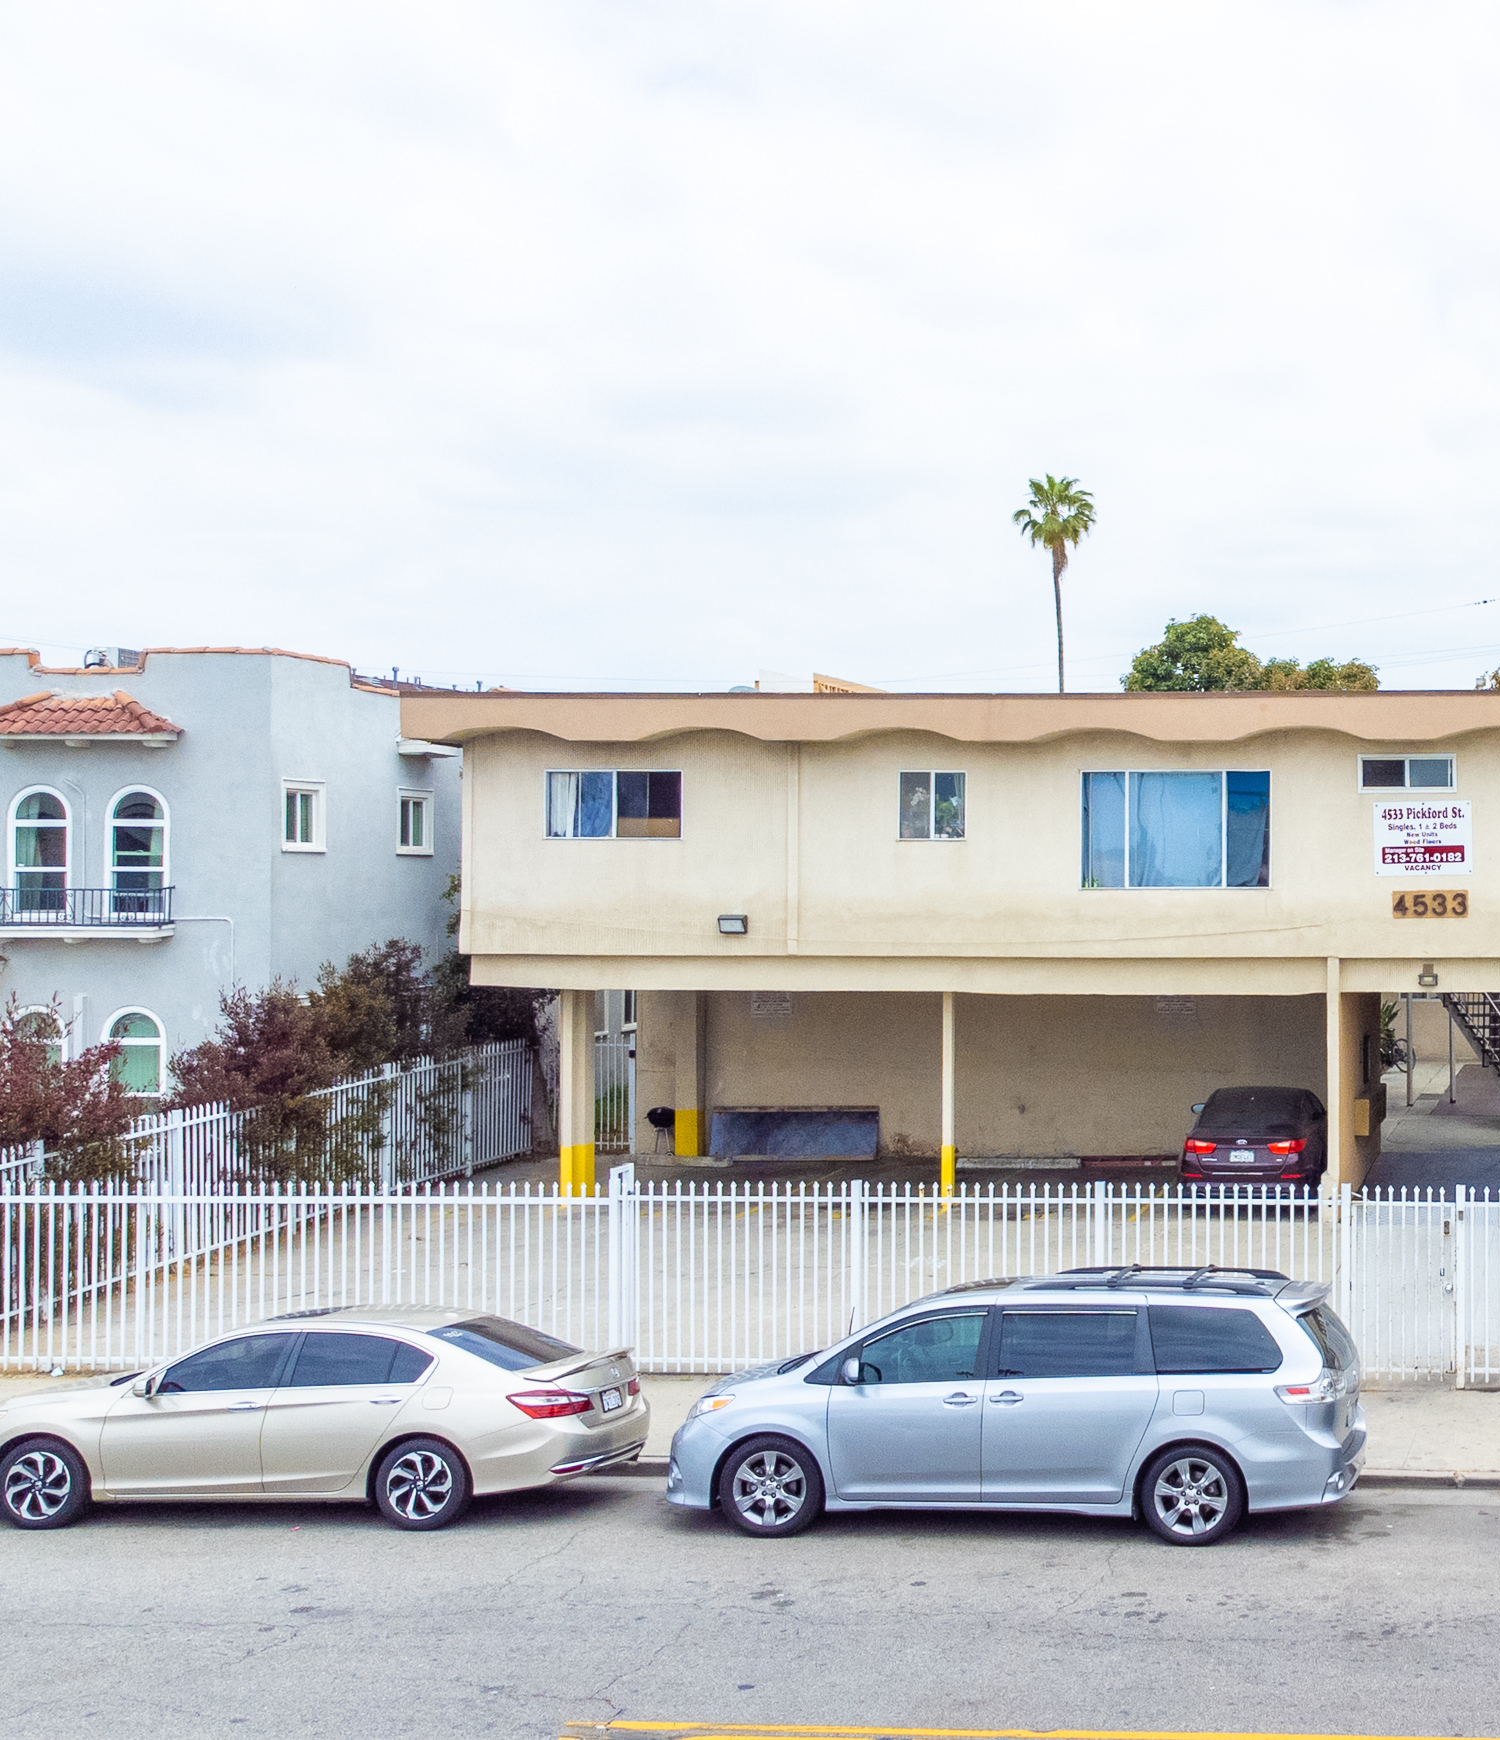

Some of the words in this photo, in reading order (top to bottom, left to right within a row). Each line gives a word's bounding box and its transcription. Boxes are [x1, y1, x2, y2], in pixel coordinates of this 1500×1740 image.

[1381, 808, 1404, 820] 4533
[1406, 807, 1448, 819] Pickford
[1451, 806, 1465, 819] St.
[1439, 822, 1457, 830] Beds
[1384, 852, 1462, 863] 213-761-0182
[1393, 893, 1467, 916] 4533
